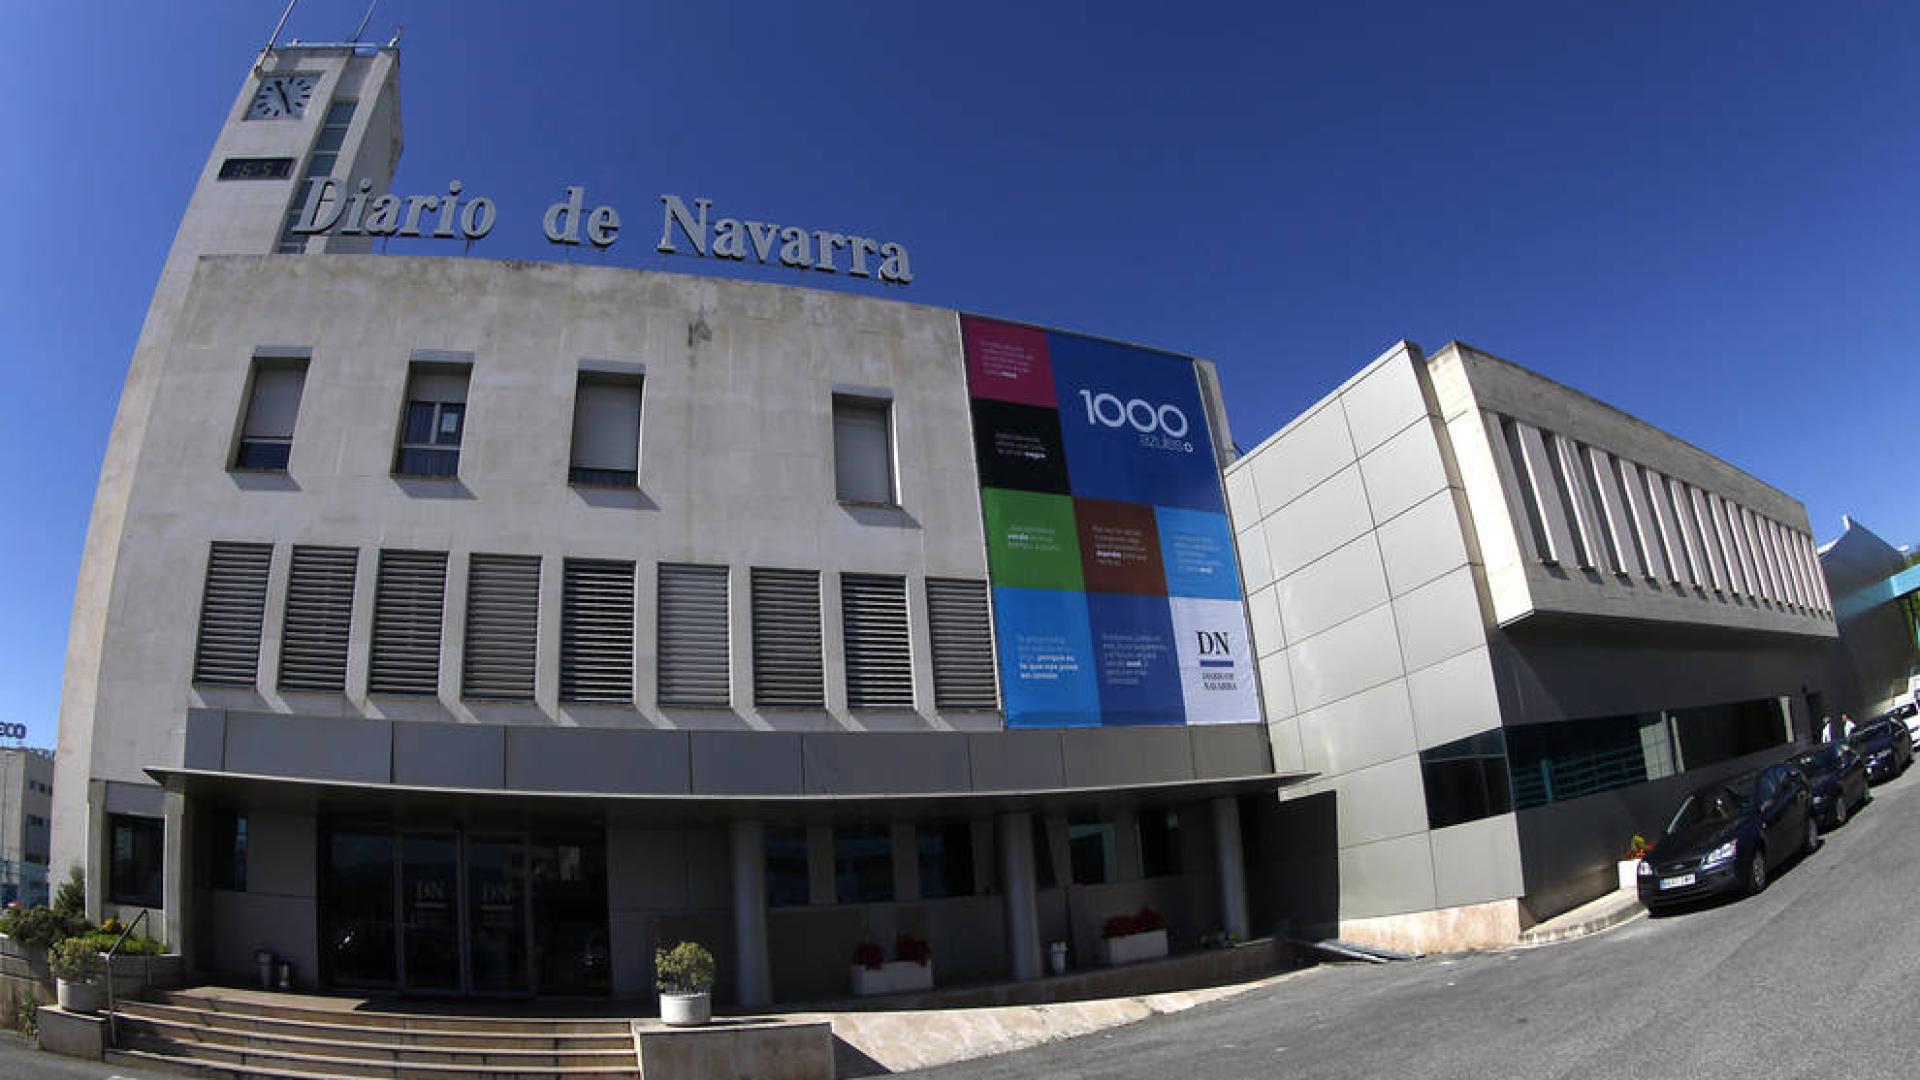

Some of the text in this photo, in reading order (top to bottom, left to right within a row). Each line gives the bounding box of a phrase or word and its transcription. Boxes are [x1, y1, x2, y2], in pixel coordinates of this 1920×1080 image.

[292, 176, 914, 284] Diario de Navarra
[1079, 388, 1188, 438] 1000
[1196, 630, 1230, 655] DN
[1204, 682, 1238, 692] NAVARRA
